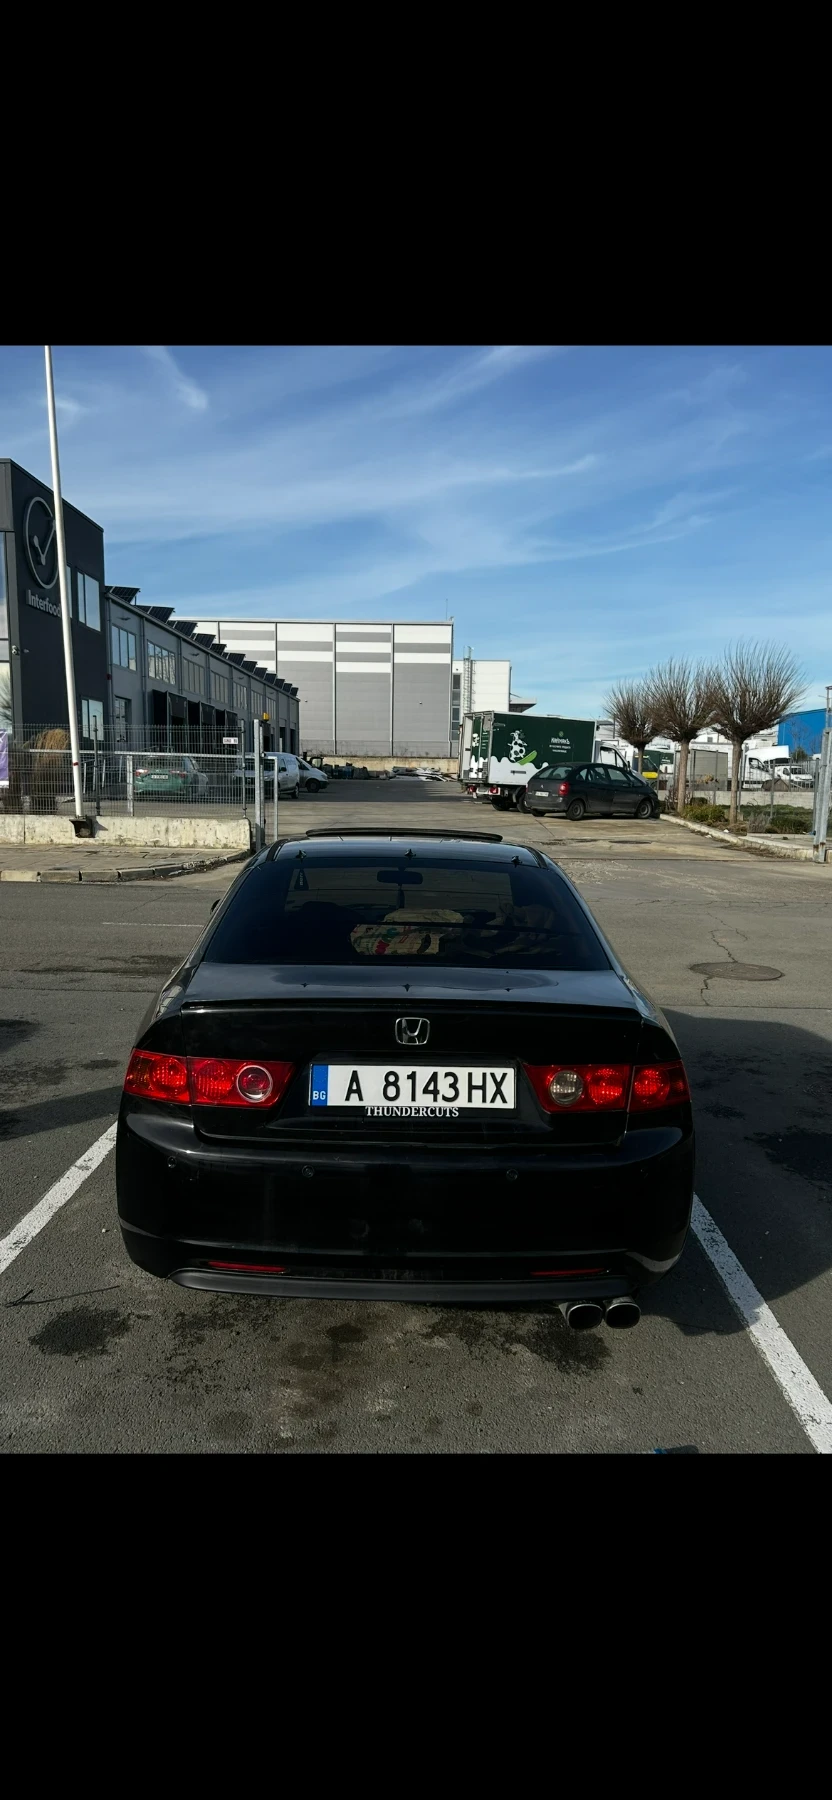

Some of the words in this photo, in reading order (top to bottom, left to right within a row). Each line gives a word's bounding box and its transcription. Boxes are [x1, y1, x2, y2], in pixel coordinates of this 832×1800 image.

[345, 1070, 364, 1101] A
[313, 1090, 326, 1100] BG
[365, 1106, 459, 1117] THUNDERCUTS
